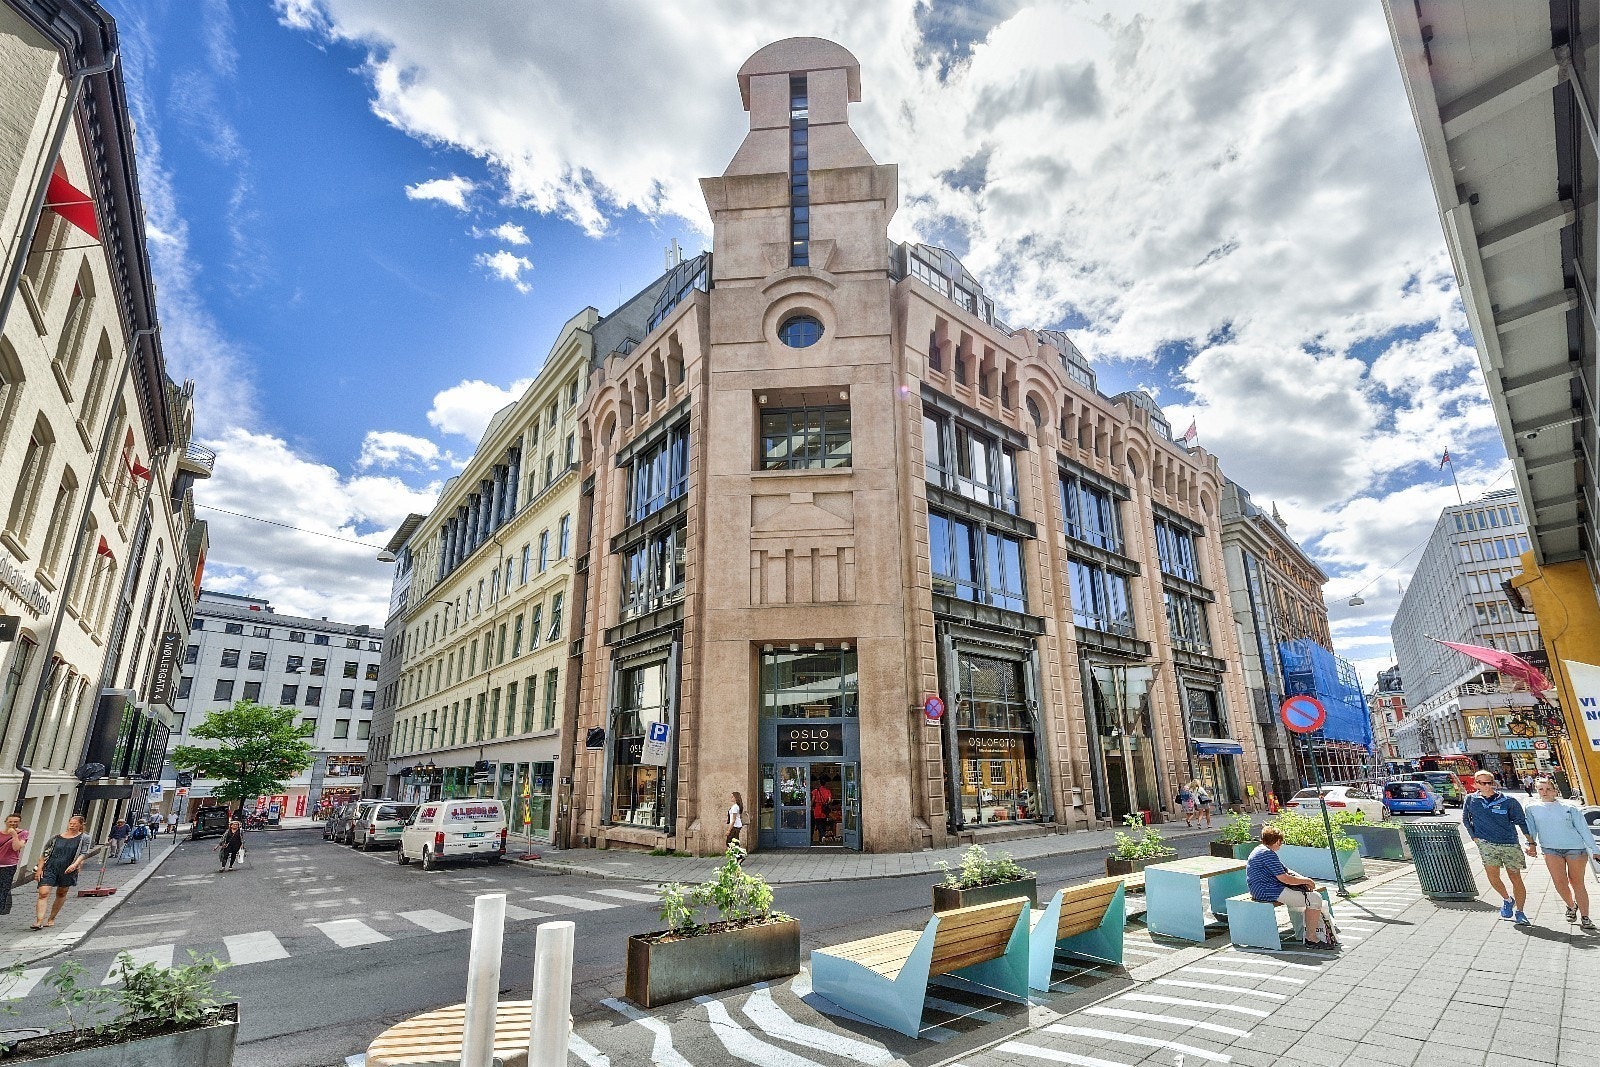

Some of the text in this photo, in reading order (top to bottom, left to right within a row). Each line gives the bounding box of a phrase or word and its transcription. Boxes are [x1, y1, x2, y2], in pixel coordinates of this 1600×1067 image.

[0, 551, 51, 615] dinavian Photo
[154, 642, 174, 693] MØLLERGATA
[1579, 697, 1597, 707] VI
[653, 724, 665, 740] P
[790, 729, 829, 740] OSLO
[790, 741, 829, 751] FOTO
[968, 737, 1016, 748] OSLOFOTO
